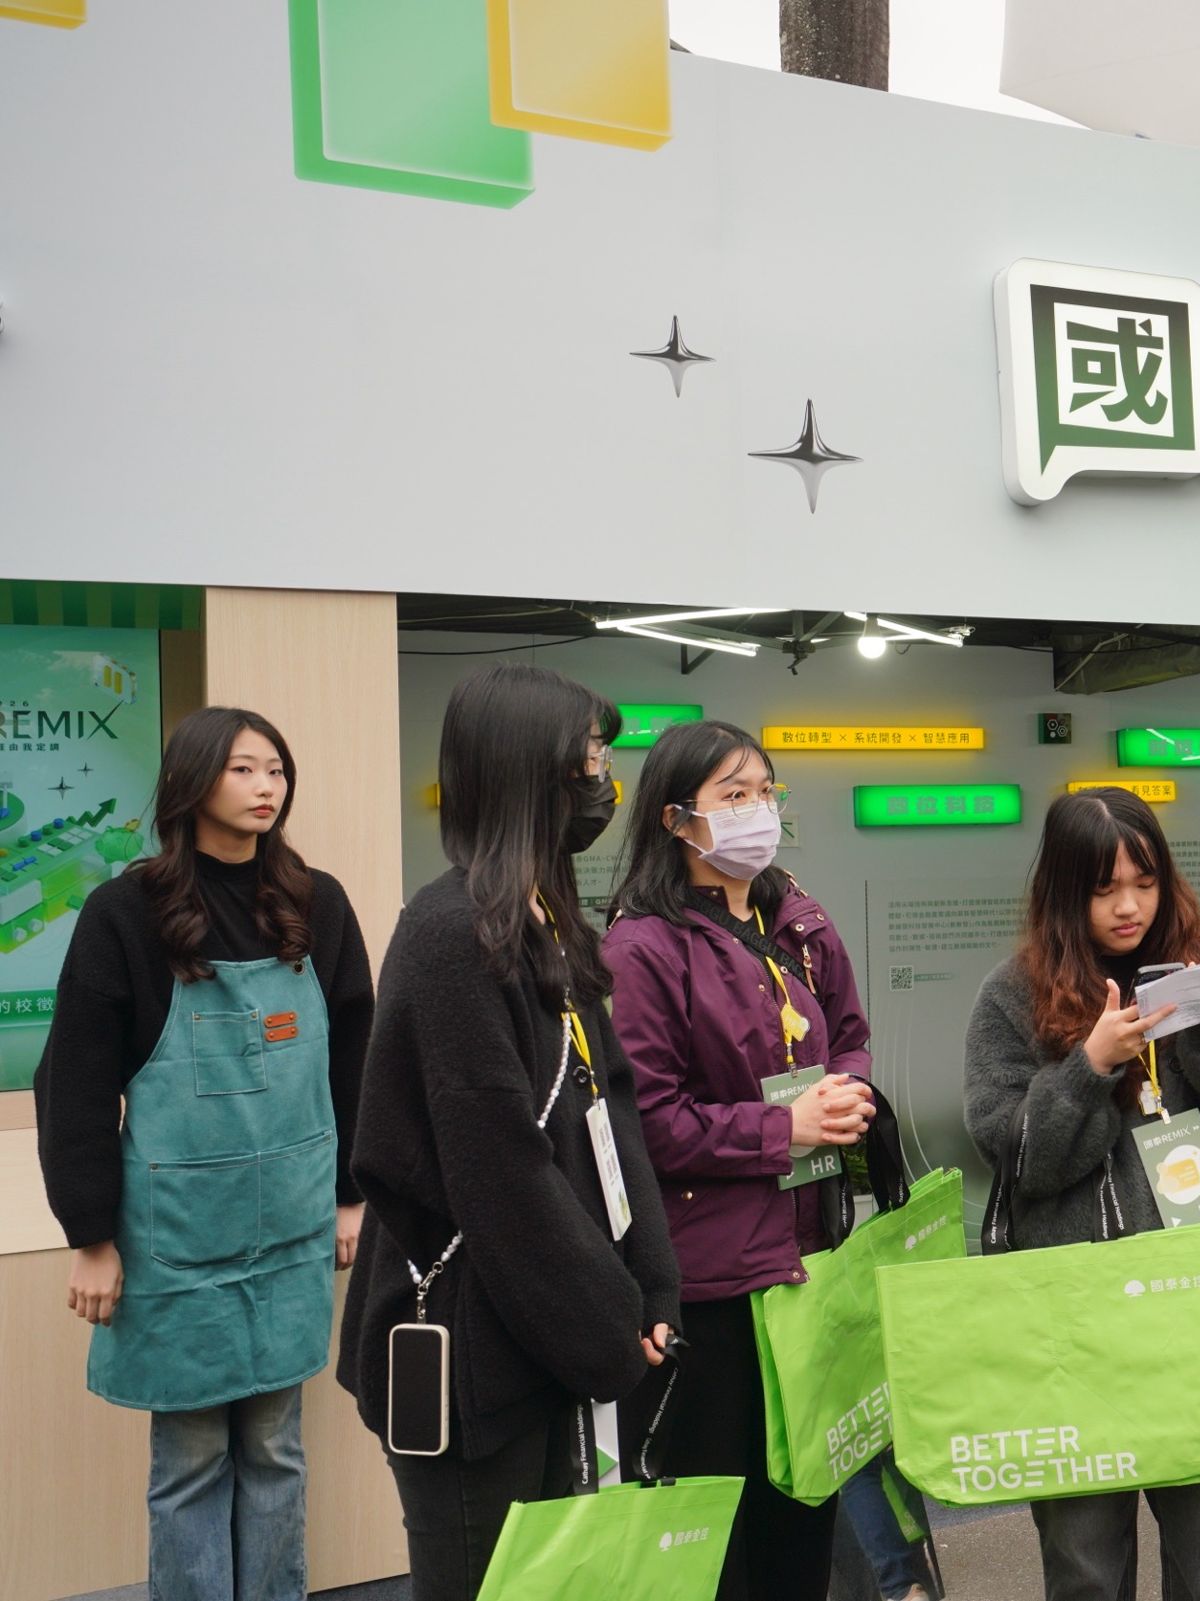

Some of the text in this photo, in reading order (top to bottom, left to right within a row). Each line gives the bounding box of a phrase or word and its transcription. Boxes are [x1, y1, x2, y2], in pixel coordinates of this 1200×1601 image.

[782, 731, 832, 743] 數位轉型
[854, 732, 902, 744] 系統開發
[923, 732, 970, 744] 智慧應用
[811, 1155, 836, 1175] HR
[951, 1426, 1081, 1463] BETTER
[581, 1462, 589, 1485] Cathay
[952, 1452, 1138, 1493] TOGETHER
